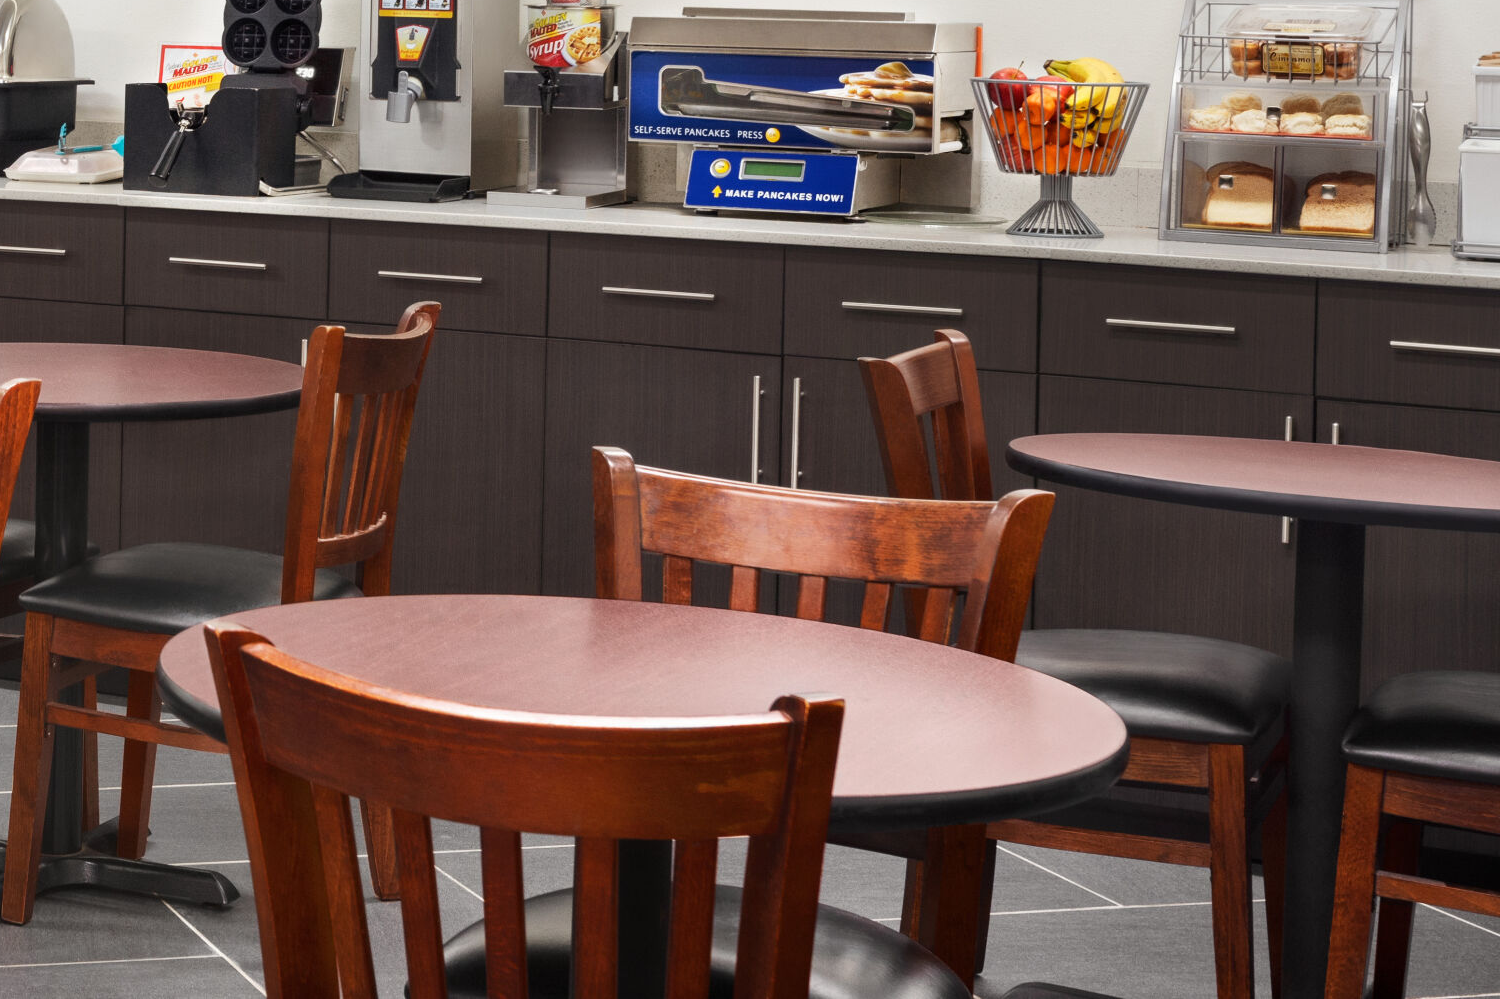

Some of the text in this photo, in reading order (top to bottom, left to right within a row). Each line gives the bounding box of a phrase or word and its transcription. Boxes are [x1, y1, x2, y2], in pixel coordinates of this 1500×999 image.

[534, 12, 568, 28] GOLDEN
[529, 40, 564, 60] Syrup
[172, 64, 208, 78] MALTED
[168, 75, 213, 90] CAUTION HOT!
[634, 126, 682, 136] SELF-SERVE
[684, 128, 730, 138] PANCAKES
[737, 130, 763, 139] PRESS
[725, 189, 844, 203] MAKE PANCAKES NOW!
